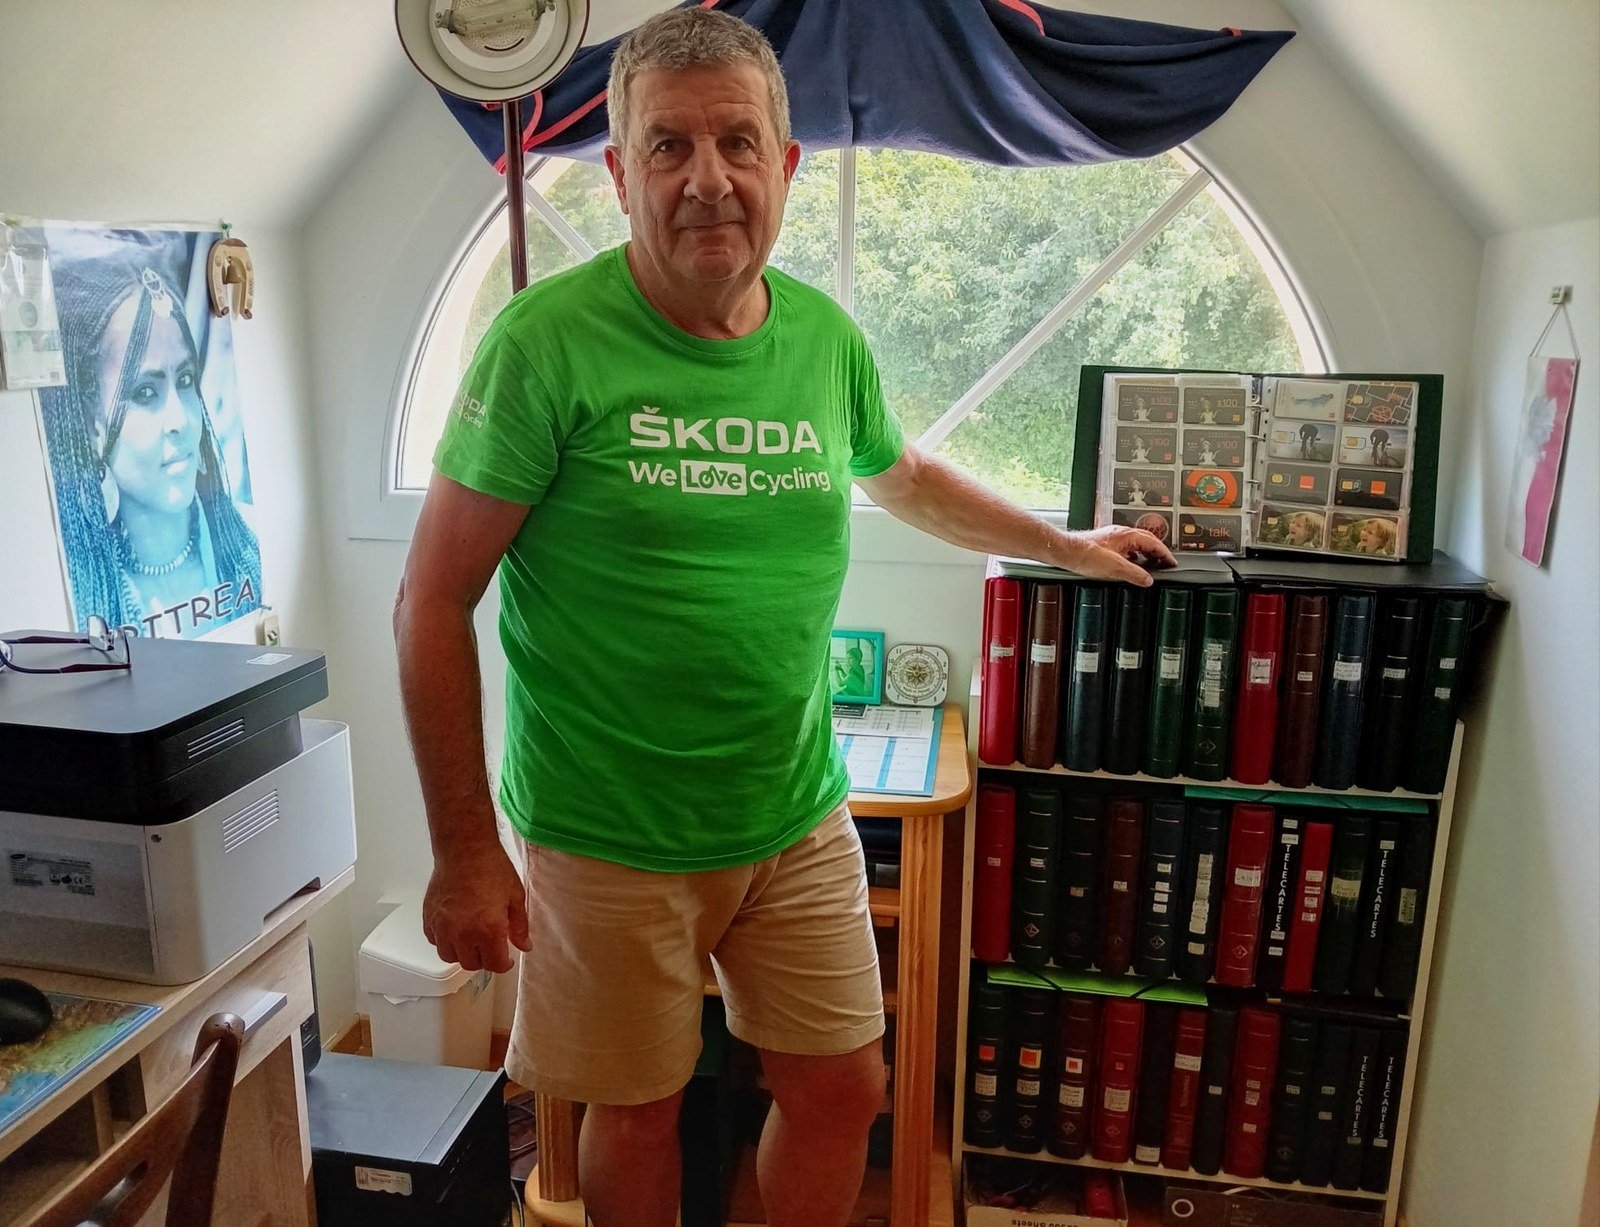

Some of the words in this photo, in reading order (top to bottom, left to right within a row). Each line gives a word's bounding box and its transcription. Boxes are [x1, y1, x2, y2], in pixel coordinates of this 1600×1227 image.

[629, 405, 823, 454] ŠKODA
[628, 461, 677, 487] We
[685, 464, 742, 490] Love
[750, 466, 831, 496] Cycling
[1209, 526, 1230, 537] talk
[1274, 844, 1292, 931] TELECARTES
[1370, 850, 1389, 938] TELECARTES
[1352, 1055, 1369, 1136] TELECARTES
[1378, 1056, 1395, 1138] TELECARTES
